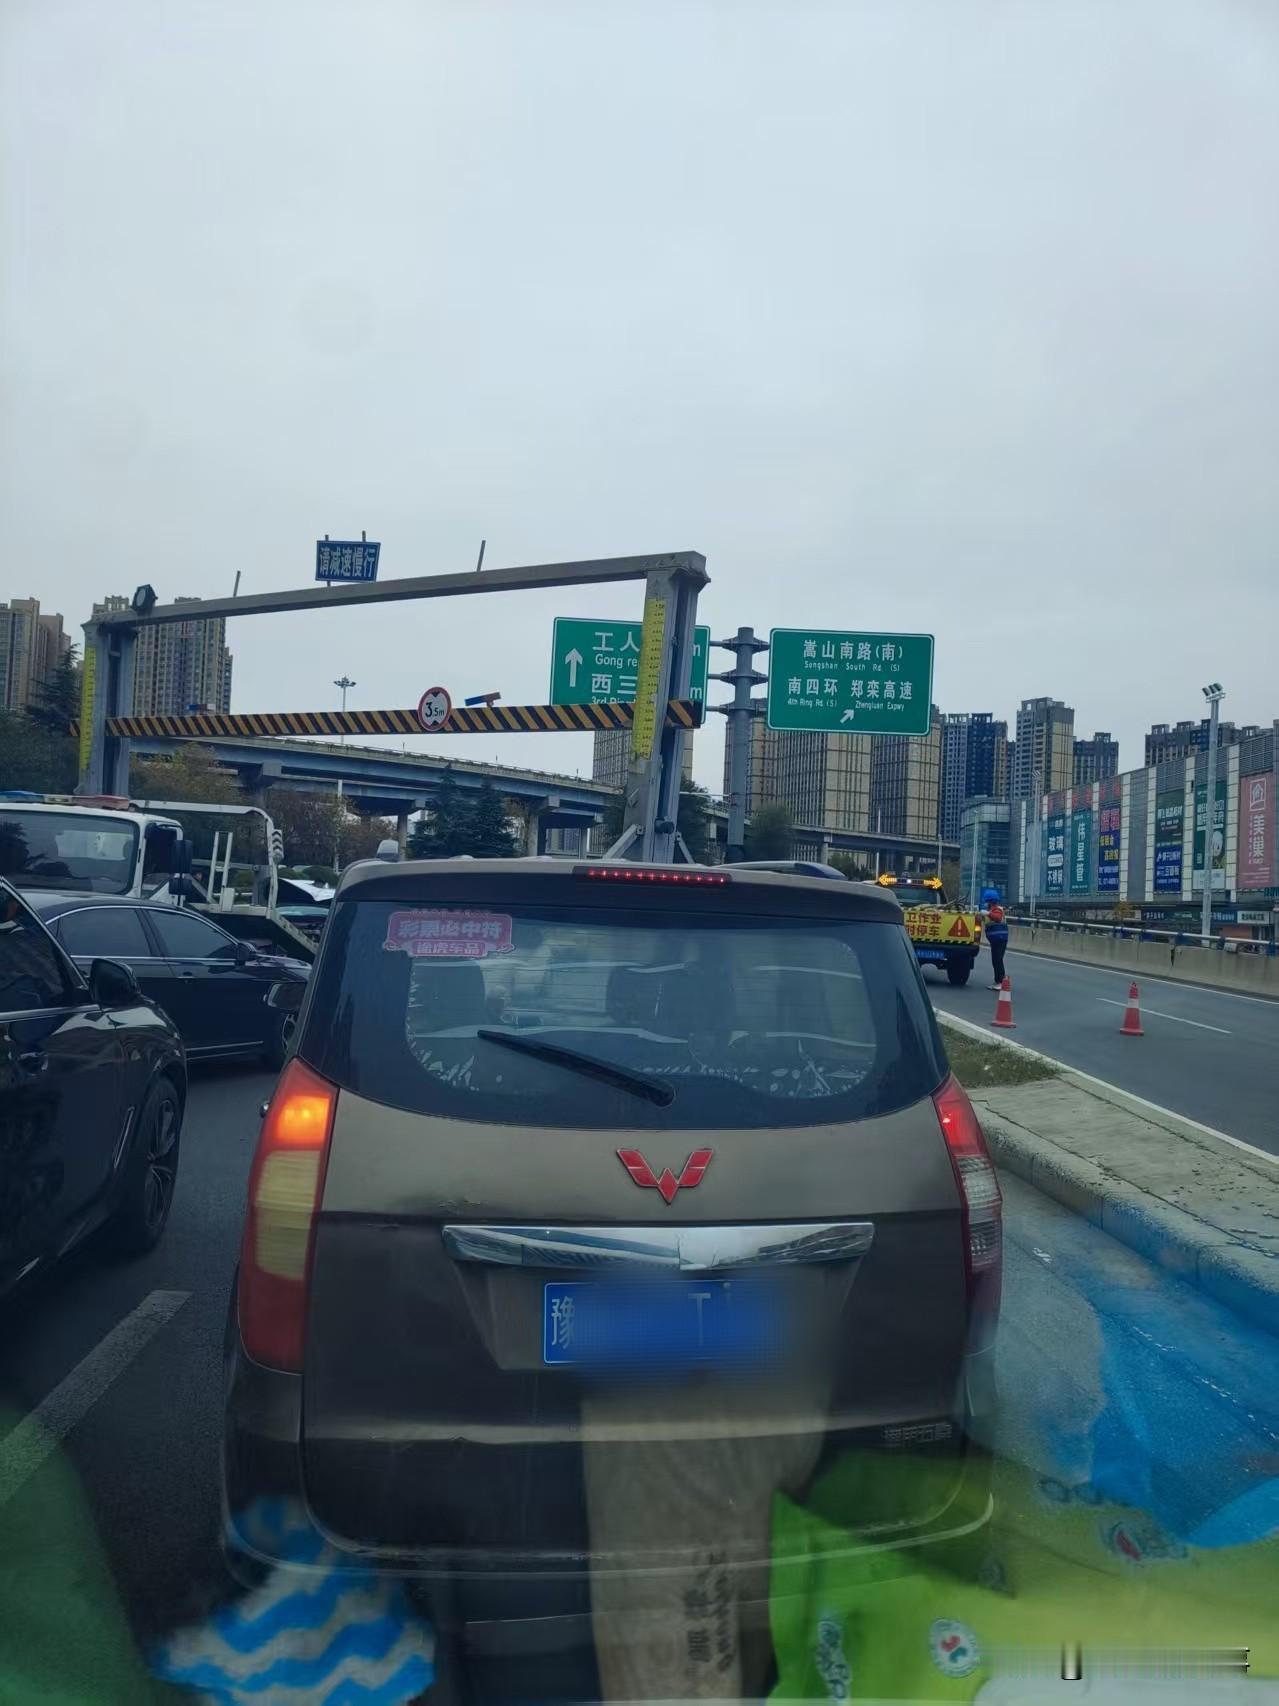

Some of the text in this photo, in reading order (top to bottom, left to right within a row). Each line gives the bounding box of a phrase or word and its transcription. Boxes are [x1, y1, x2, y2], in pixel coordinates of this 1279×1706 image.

[320, 546, 376, 577] 请减速慢行
[803, 640, 903, 661] 嵩山南路(南)
[595, 654, 623, 669] Gong
[804, 660, 838, 671] Songshan
[846, 662, 865, 671] South
[788, 676, 912, 700] 南四环 郑栾高速
